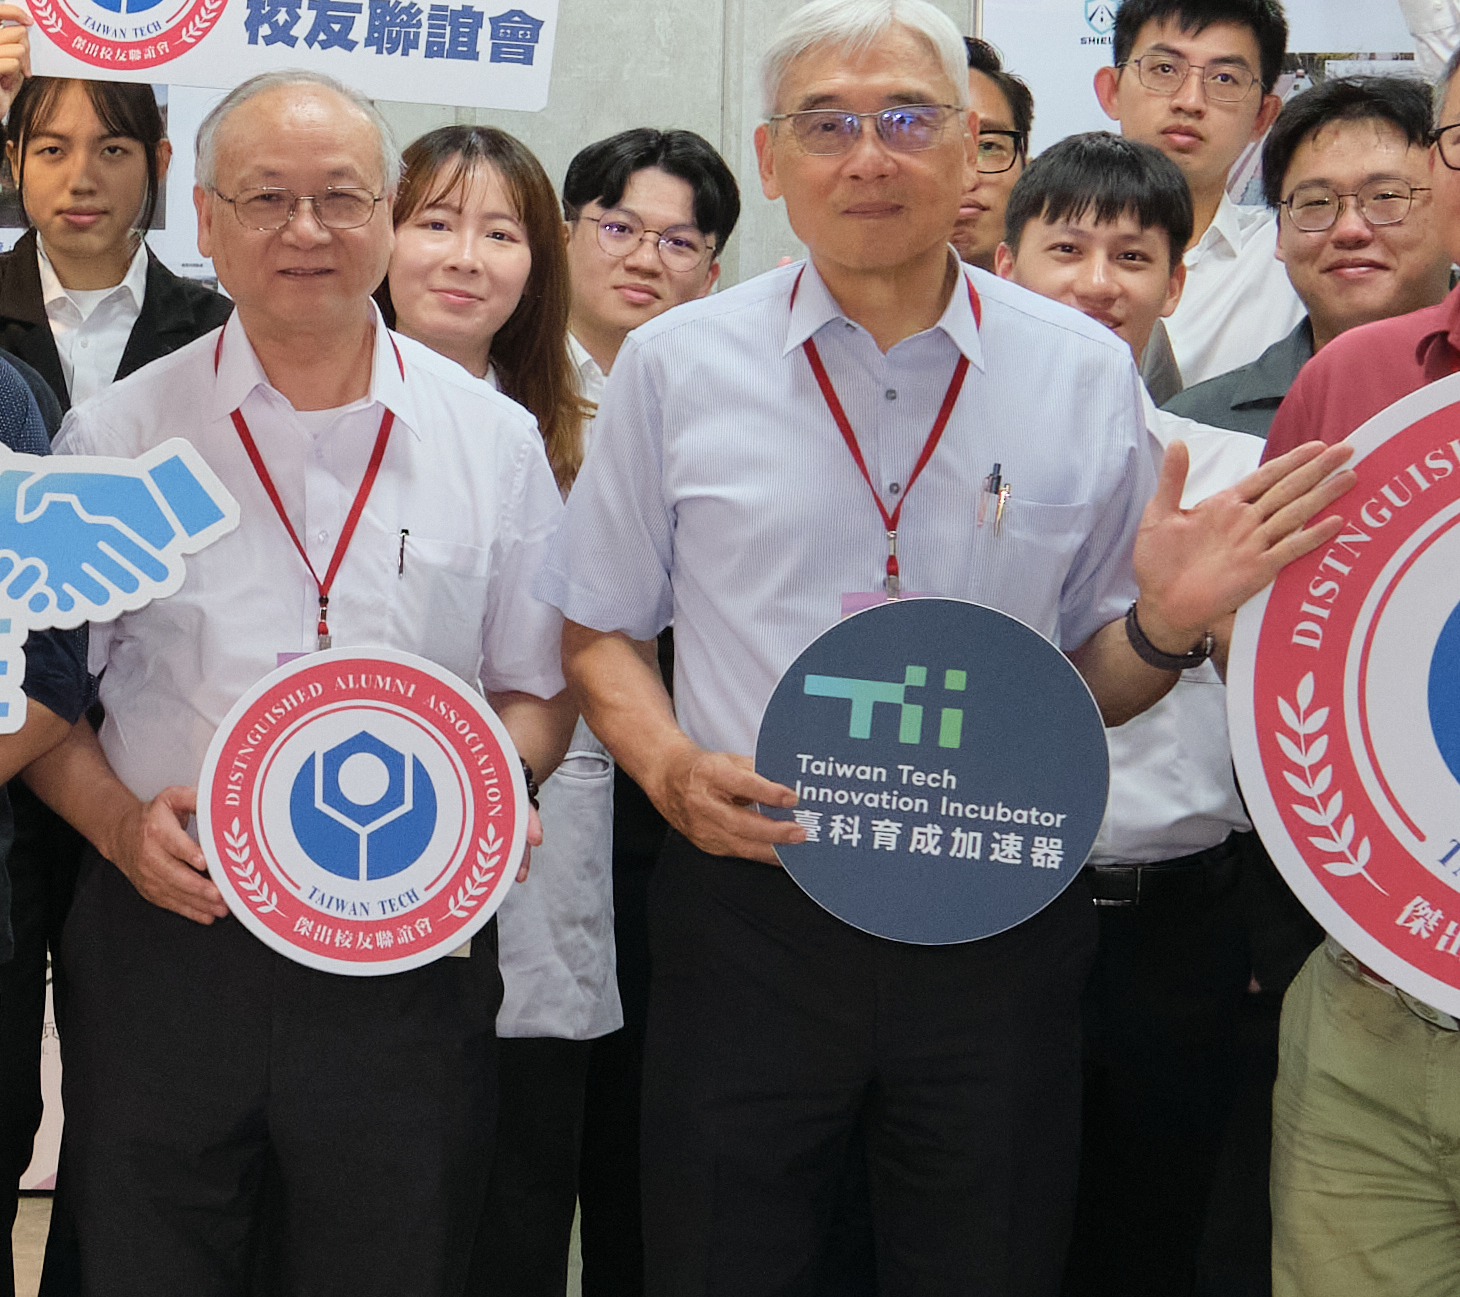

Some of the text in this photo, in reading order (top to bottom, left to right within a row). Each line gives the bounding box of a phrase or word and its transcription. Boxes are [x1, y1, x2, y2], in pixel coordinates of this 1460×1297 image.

[83, 15, 162, 39] TAIWAN TECH
[1080, 36, 1113, 45] SHIEL
[225, 674, 503, 817] DISTNGUISHED ALUMNI ASSOCIATION
[796, 753, 957, 790] Taiwan Tech
[795, 781, 1067, 828] Innovation Incubator
[792, 809, 1064, 870] 臺科育成加速器
[307, 885, 420, 917] TAIWAN TECH
[293, 915, 433, 950] 傑出校友聯誼會
